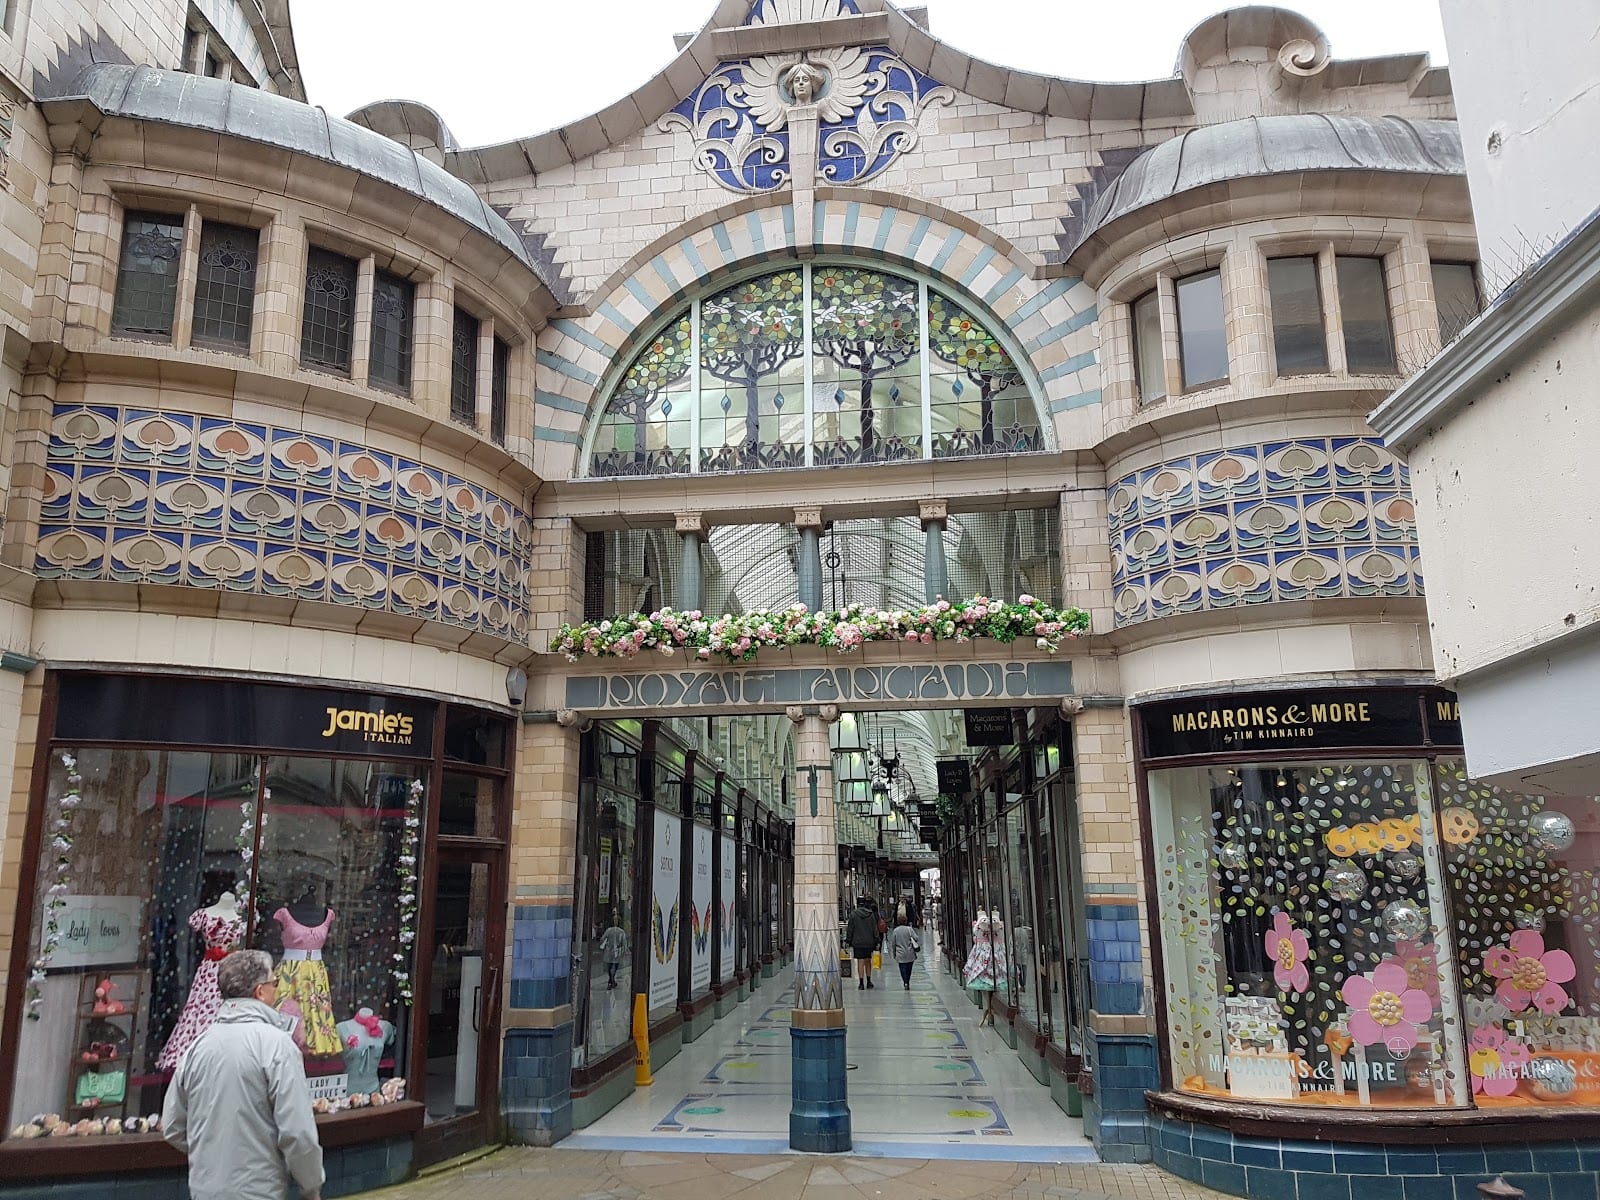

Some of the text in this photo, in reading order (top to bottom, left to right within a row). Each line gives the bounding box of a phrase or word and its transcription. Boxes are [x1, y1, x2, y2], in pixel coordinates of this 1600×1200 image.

[602, 662, 1028, 708] ROYAL ARCADE
[322, 707, 414, 737] Jamie's
[983, 723, 1005, 732] More
[1172, 702, 1371, 732] MACARONS & MORE
[364, 732, 412, 745] ITALIAN
[1223, 727, 1314, 743] by TIM KINNAIRD
[66, 920, 90, 946] Lady
[1209, 1053, 1397, 1081] MACARONS & MORE
[310, 1078, 330, 1089] LADY
